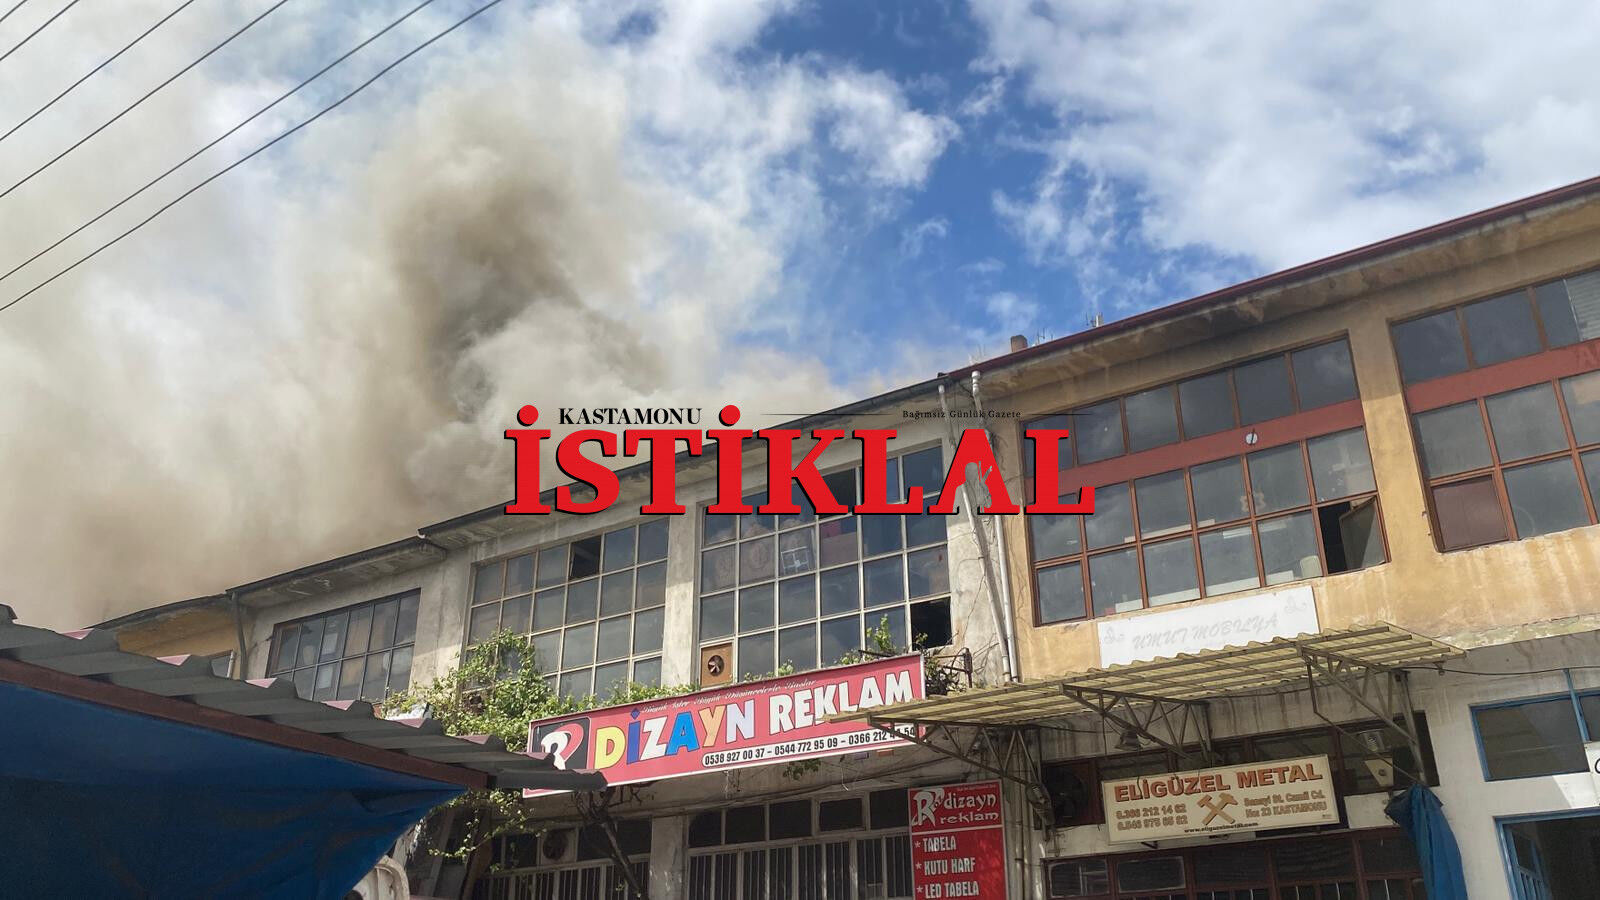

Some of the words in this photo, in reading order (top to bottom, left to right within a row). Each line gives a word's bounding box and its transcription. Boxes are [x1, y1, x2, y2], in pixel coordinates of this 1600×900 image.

[594, 698, 755, 770] DİZAYN
[769, 670, 914, 735] REKLAM
[704, 753, 725, 766] 0538
[726, 751, 741, 763] 927
[742, 749, 753, 760] 00
[755, 747, 765, 758] 37
[774, 743, 796, 756] 0544
[797, 740, 812, 752] 772
[814, 739, 825, 750] 95
[827, 737, 838, 748] 09
[848, 732, 871, 745] 0366
[872, 730, 887, 742] 212
[1114, 774, 1231, 803] ELİGÜZEL
[1235, 763, 1323, 788] METAL
[943, 792, 997, 811] dizayn
[1273, 801, 1328, 816] KASTAMONU
[940, 811, 999, 824] reklam
[923, 835, 957, 853] TABELA
[924, 859, 948, 876] KUTU
[951, 857, 976, 874] HARF
[925, 882, 942, 899] LED
[944, 880, 980, 898] TABELA
